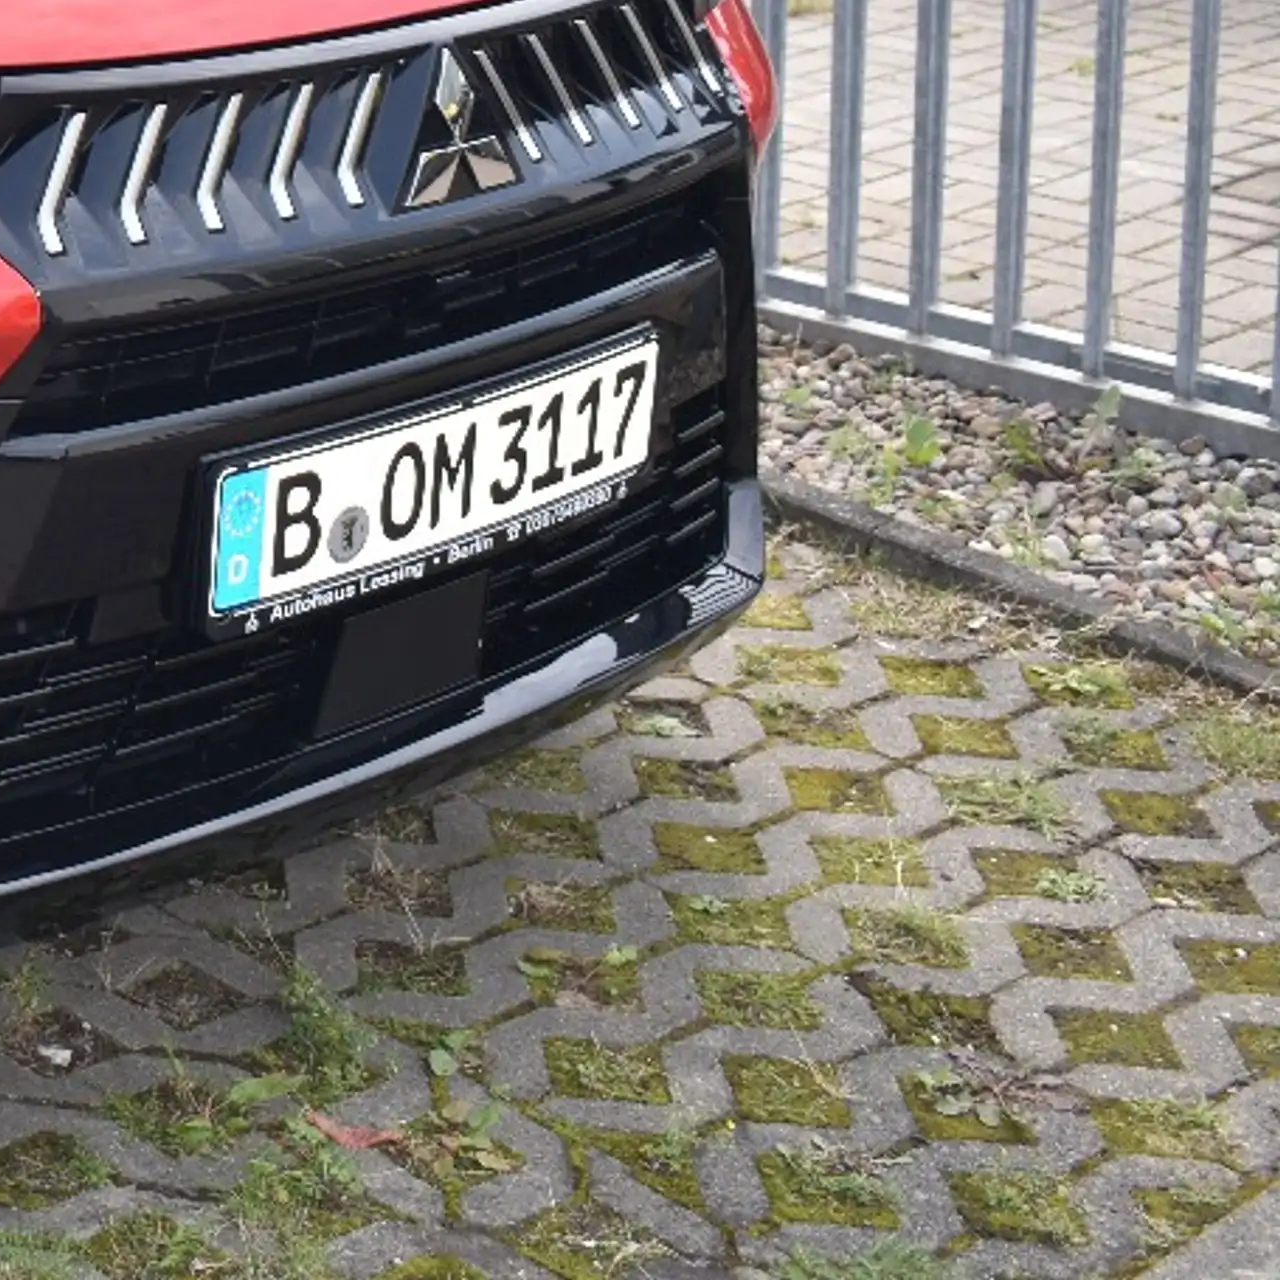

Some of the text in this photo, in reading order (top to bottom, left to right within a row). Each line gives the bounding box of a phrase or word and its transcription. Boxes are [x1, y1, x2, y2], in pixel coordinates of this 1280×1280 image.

[269, 469, 323, 579] B
[379, 420, 478, 542] OM
[488, 358, 648, 507] 3117
[226, 553, 248, 586] D
[269, 535, 495, 624] Autohaus Lessing Berlin
